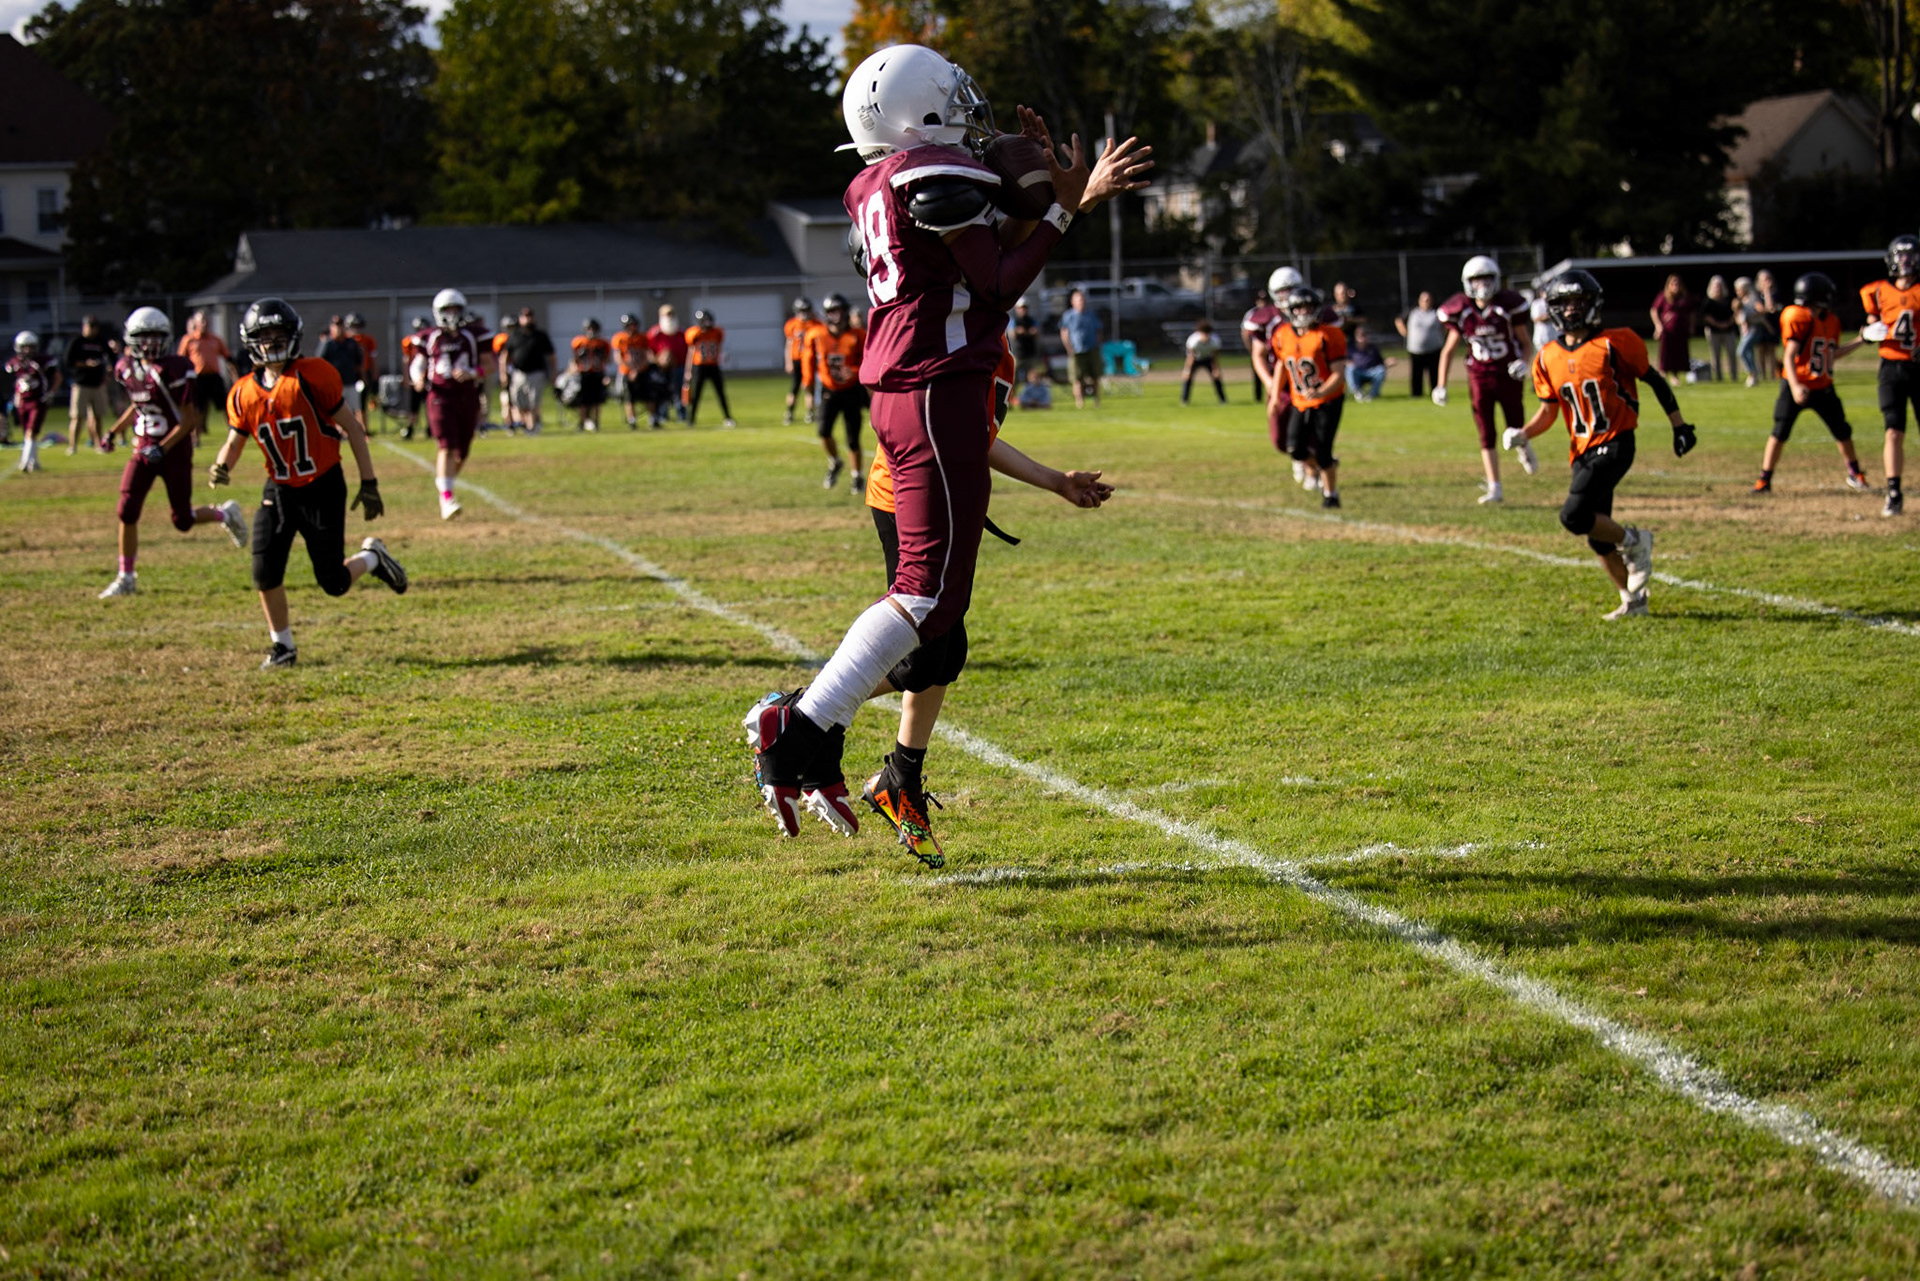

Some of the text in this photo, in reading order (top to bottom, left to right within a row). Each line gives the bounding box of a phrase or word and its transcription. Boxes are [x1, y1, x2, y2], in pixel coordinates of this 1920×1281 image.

[857, 190, 899, 308] 19
[1893, 309, 1915, 350] 4
[1284, 356, 1324, 394] 12
[1561, 378, 1610, 438] 11
[258, 415, 317, 480] 17
